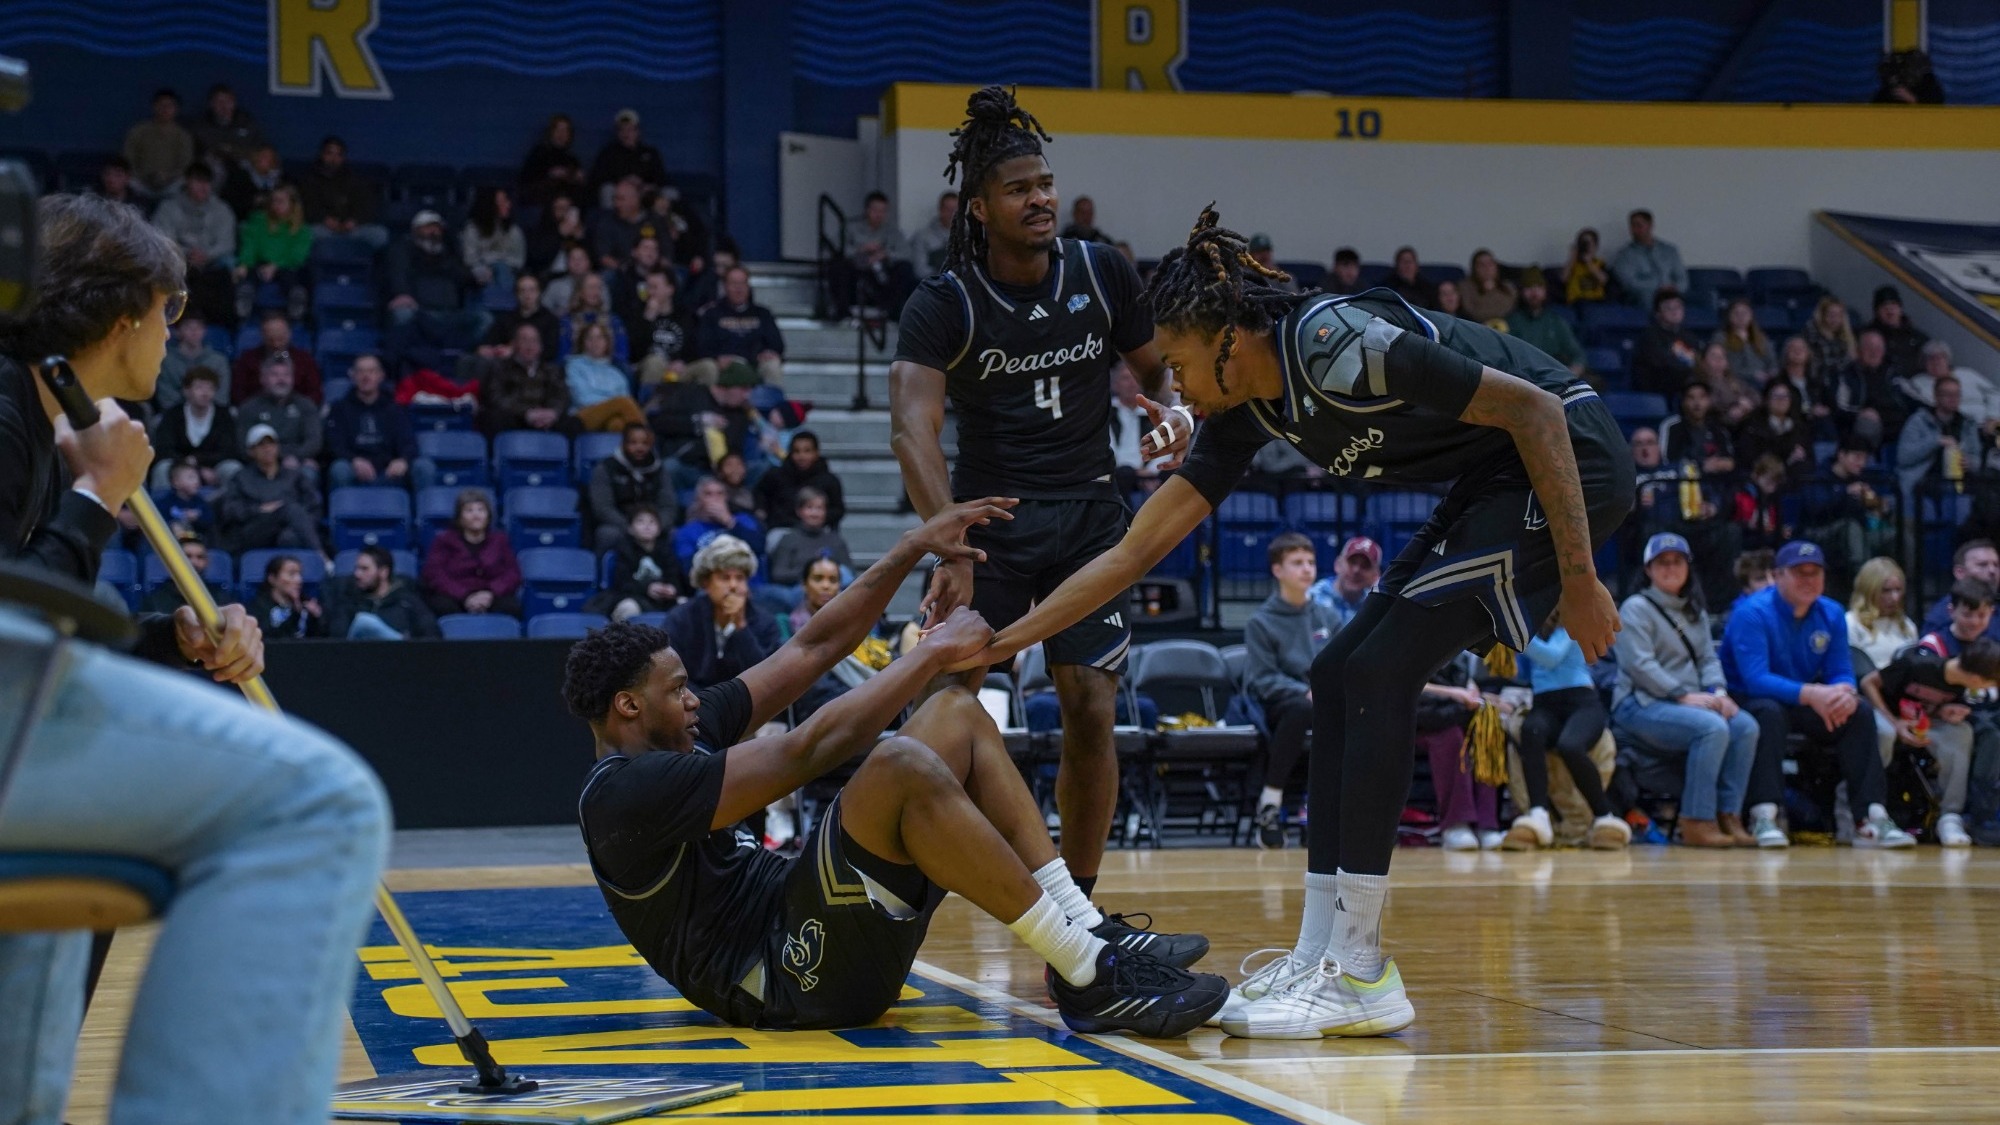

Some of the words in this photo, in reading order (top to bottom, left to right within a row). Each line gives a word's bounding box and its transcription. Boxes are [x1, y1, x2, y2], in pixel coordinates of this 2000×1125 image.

[1089, 0, 1189, 92] R
[1335, 109, 1382, 139] 10
[978, 332, 1104, 382] Peacocks
[1033, 376, 1064, 421] 4
